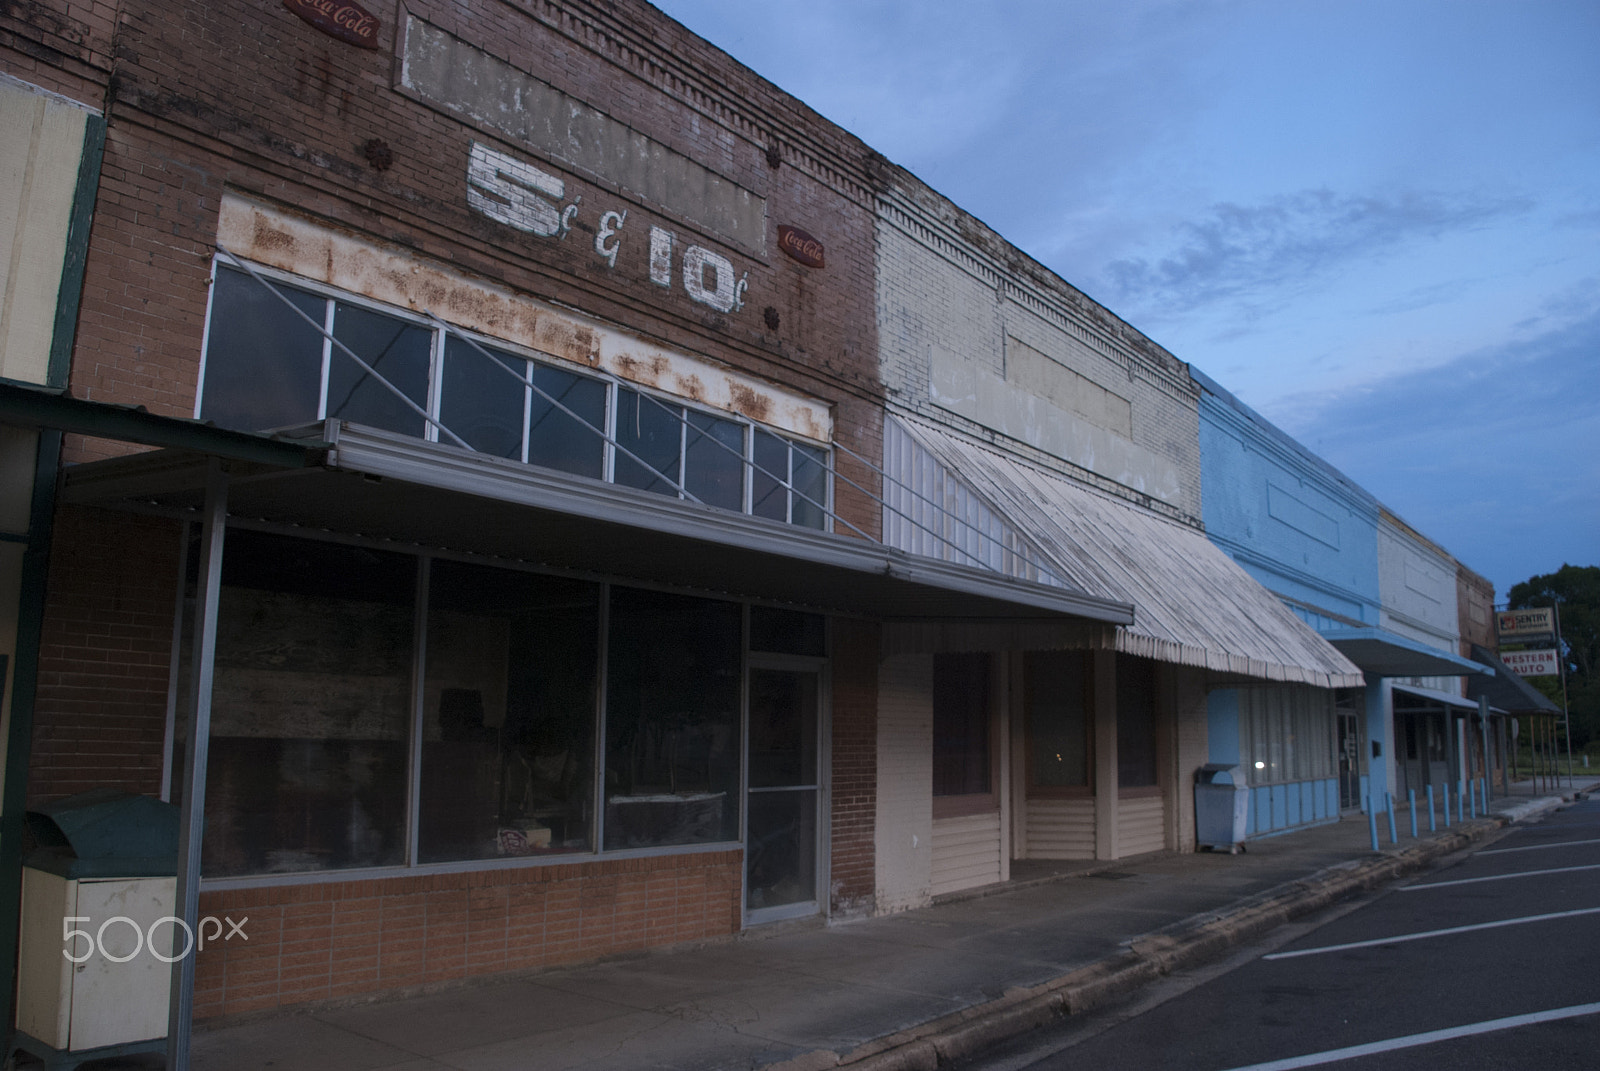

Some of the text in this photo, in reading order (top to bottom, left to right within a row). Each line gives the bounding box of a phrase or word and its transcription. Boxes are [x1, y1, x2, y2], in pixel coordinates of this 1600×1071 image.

[1515, 614, 1547, 624] SENTRY
[1502, 654, 1552, 664] WESTERN
[1513, 664, 1544, 674] AUTO
